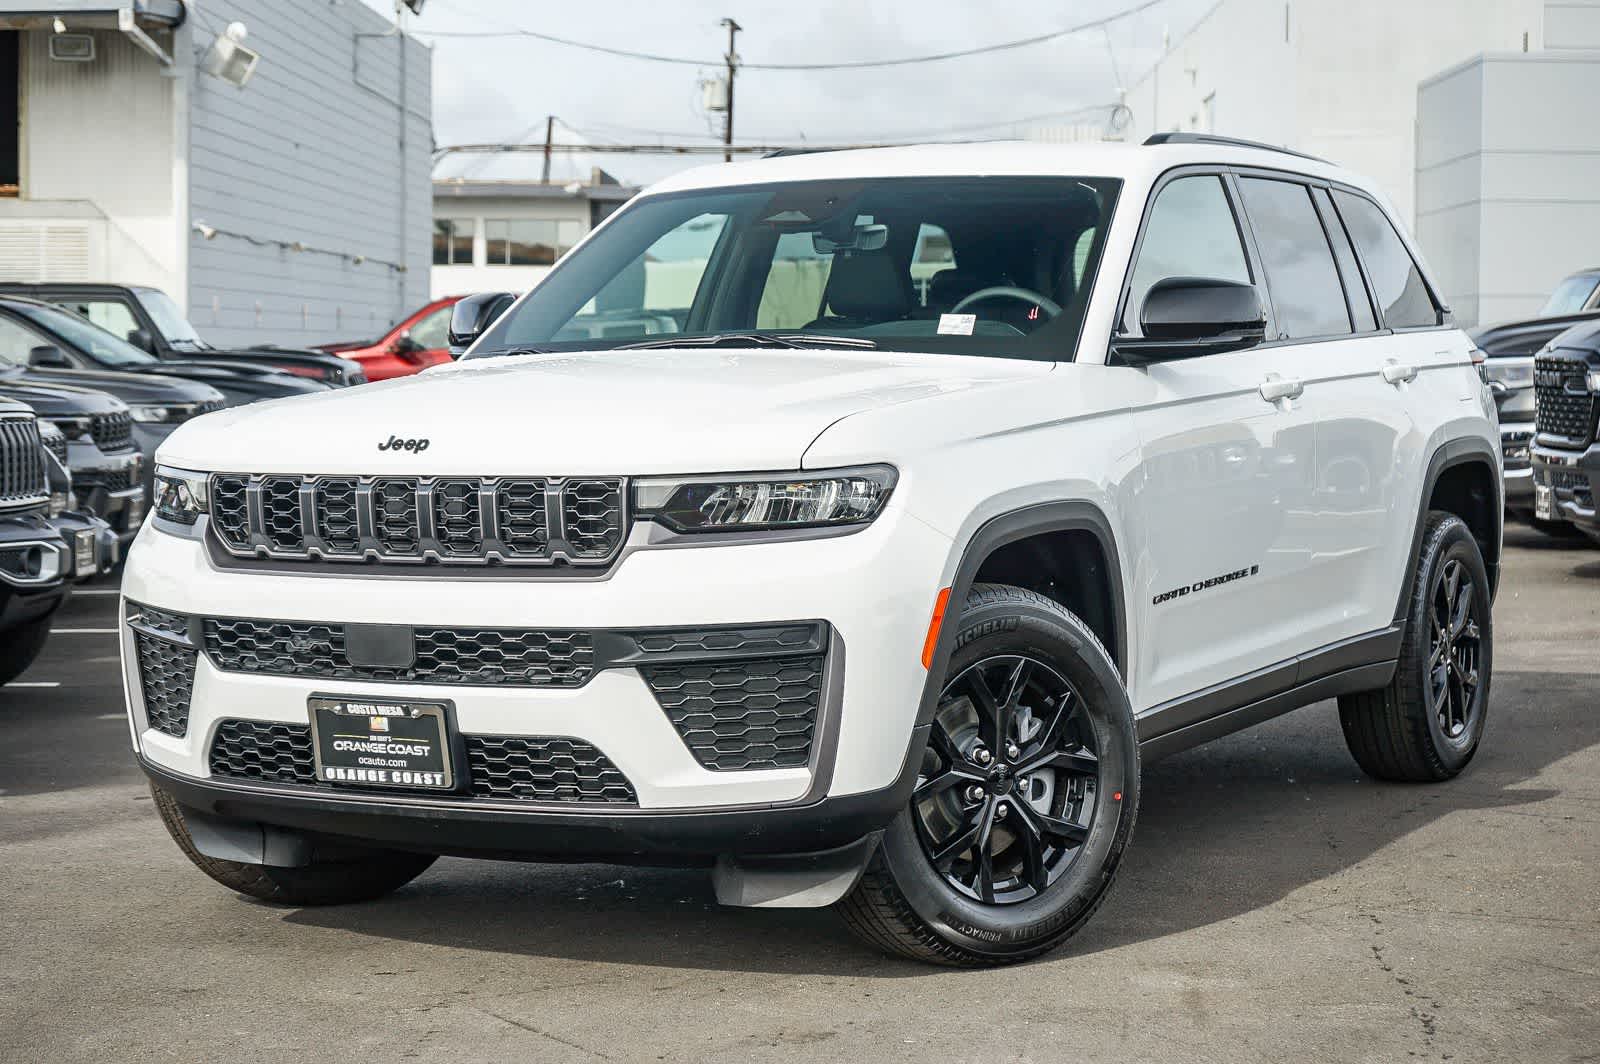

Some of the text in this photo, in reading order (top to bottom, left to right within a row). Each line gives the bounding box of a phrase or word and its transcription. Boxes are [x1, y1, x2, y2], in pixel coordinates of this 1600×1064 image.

[378, 435, 430, 454] Jeep
[1152, 567, 1249, 605] GRAND CHEROKEE
[346, 703, 405, 716] COSTA MESA
[358, 756, 407, 767] ocauto.com
[325, 767, 443, 785] ORANGE COAST
[958, 925, 1002, 942] PRIMACY
